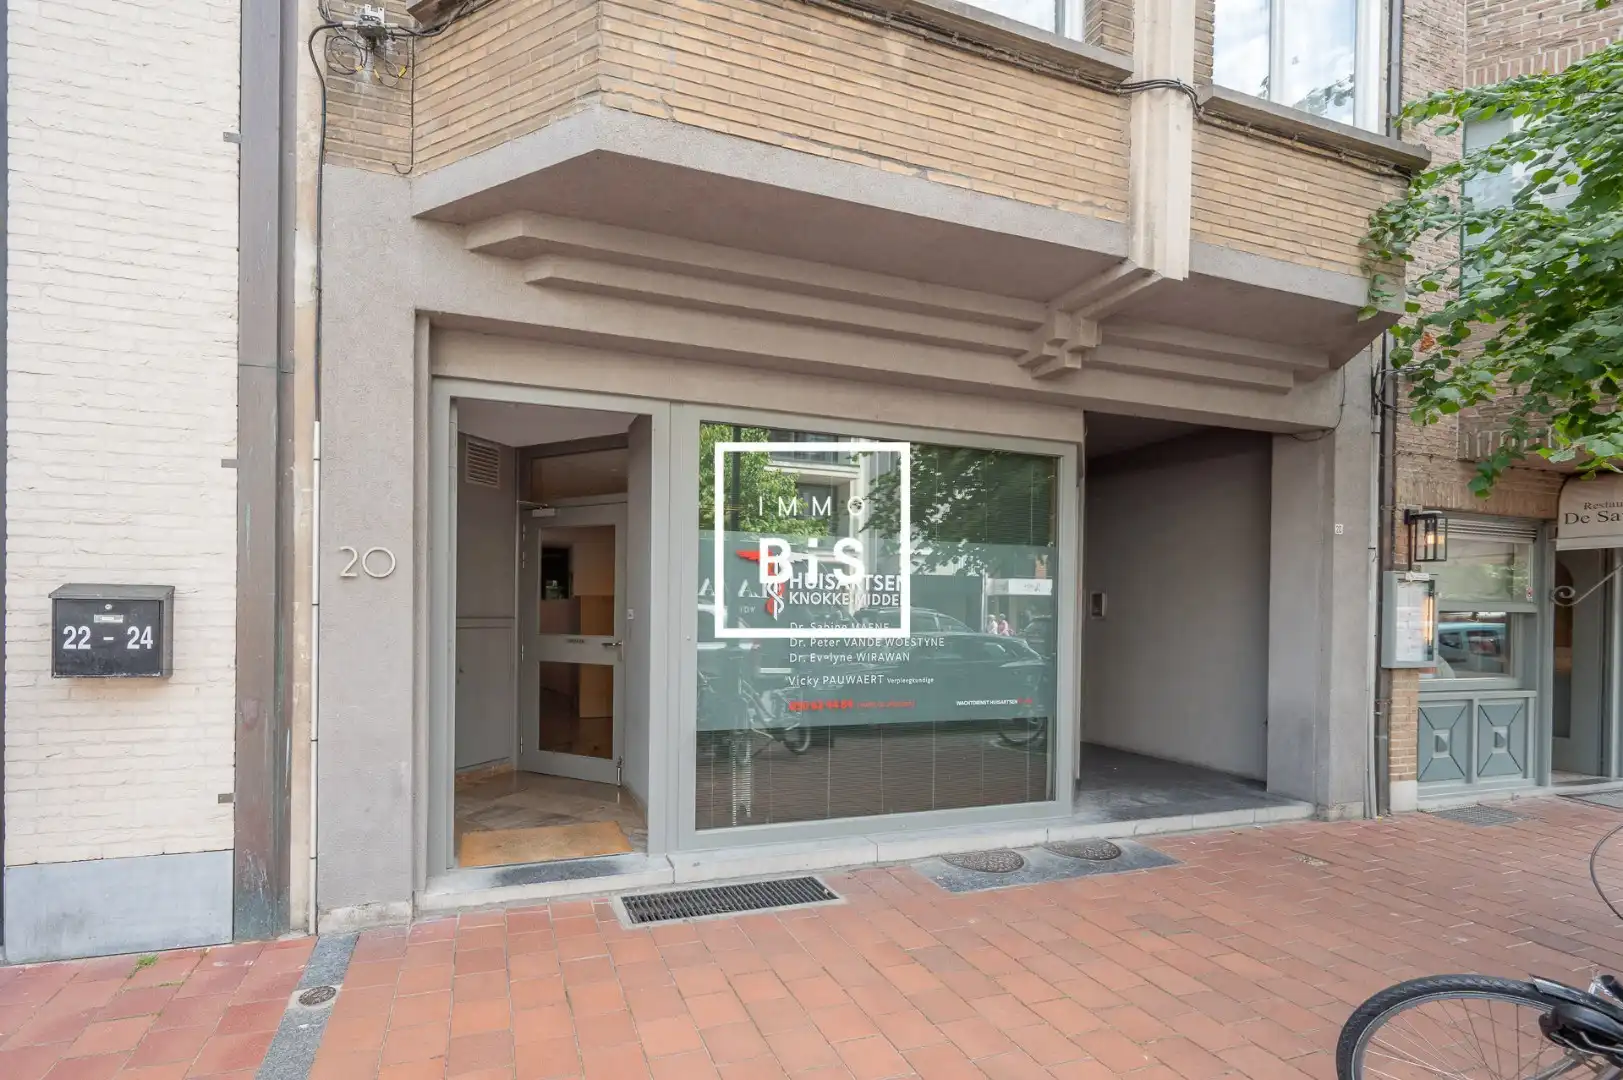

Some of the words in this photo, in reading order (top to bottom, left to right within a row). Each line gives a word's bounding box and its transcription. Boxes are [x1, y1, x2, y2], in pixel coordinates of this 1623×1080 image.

[1564, 512, 1591, 525] De
[339, 546, 397, 579] 20
[62, 626, 92, 650] 22
[126, 625, 154, 650] 24
[789, 638, 806, 648] Dr.
[810, 638, 841, 648] Peter
[843, 638, 881, 648] VANDE
[885, 637, 945, 648] WOESTYNE
[789, 653, 806, 663] Dr.
[810, 653, 853, 665] Evelyne
[856, 652, 910, 662] WIRAWAN
[788, 675, 819, 688] Vicky
[822, 674, 885, 685] PAUWAERT
